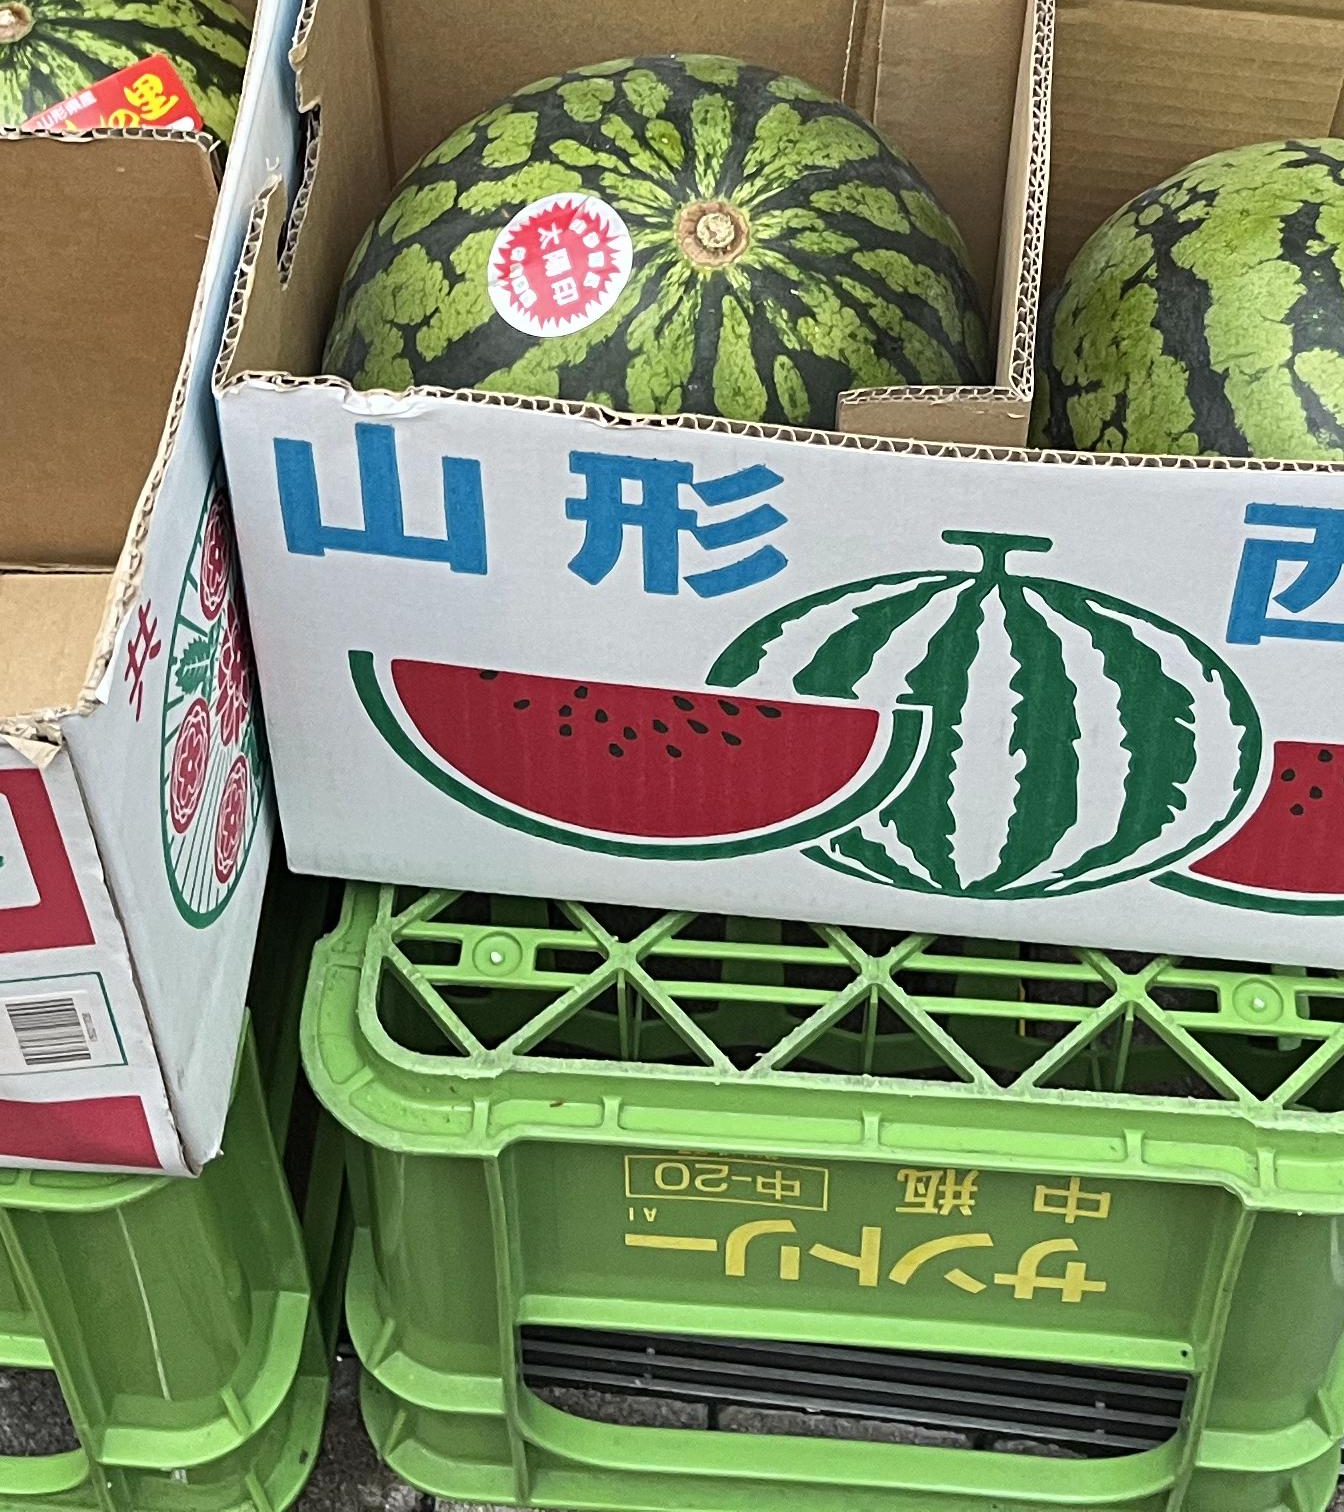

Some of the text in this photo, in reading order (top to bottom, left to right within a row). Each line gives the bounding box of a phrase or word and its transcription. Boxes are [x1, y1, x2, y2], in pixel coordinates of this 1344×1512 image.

[275, 422, 790, 600] 山形
[654, 1160, 1113, 1226] 中-20 中瓶
[623, 1218, 1107, 1304] サントリー
